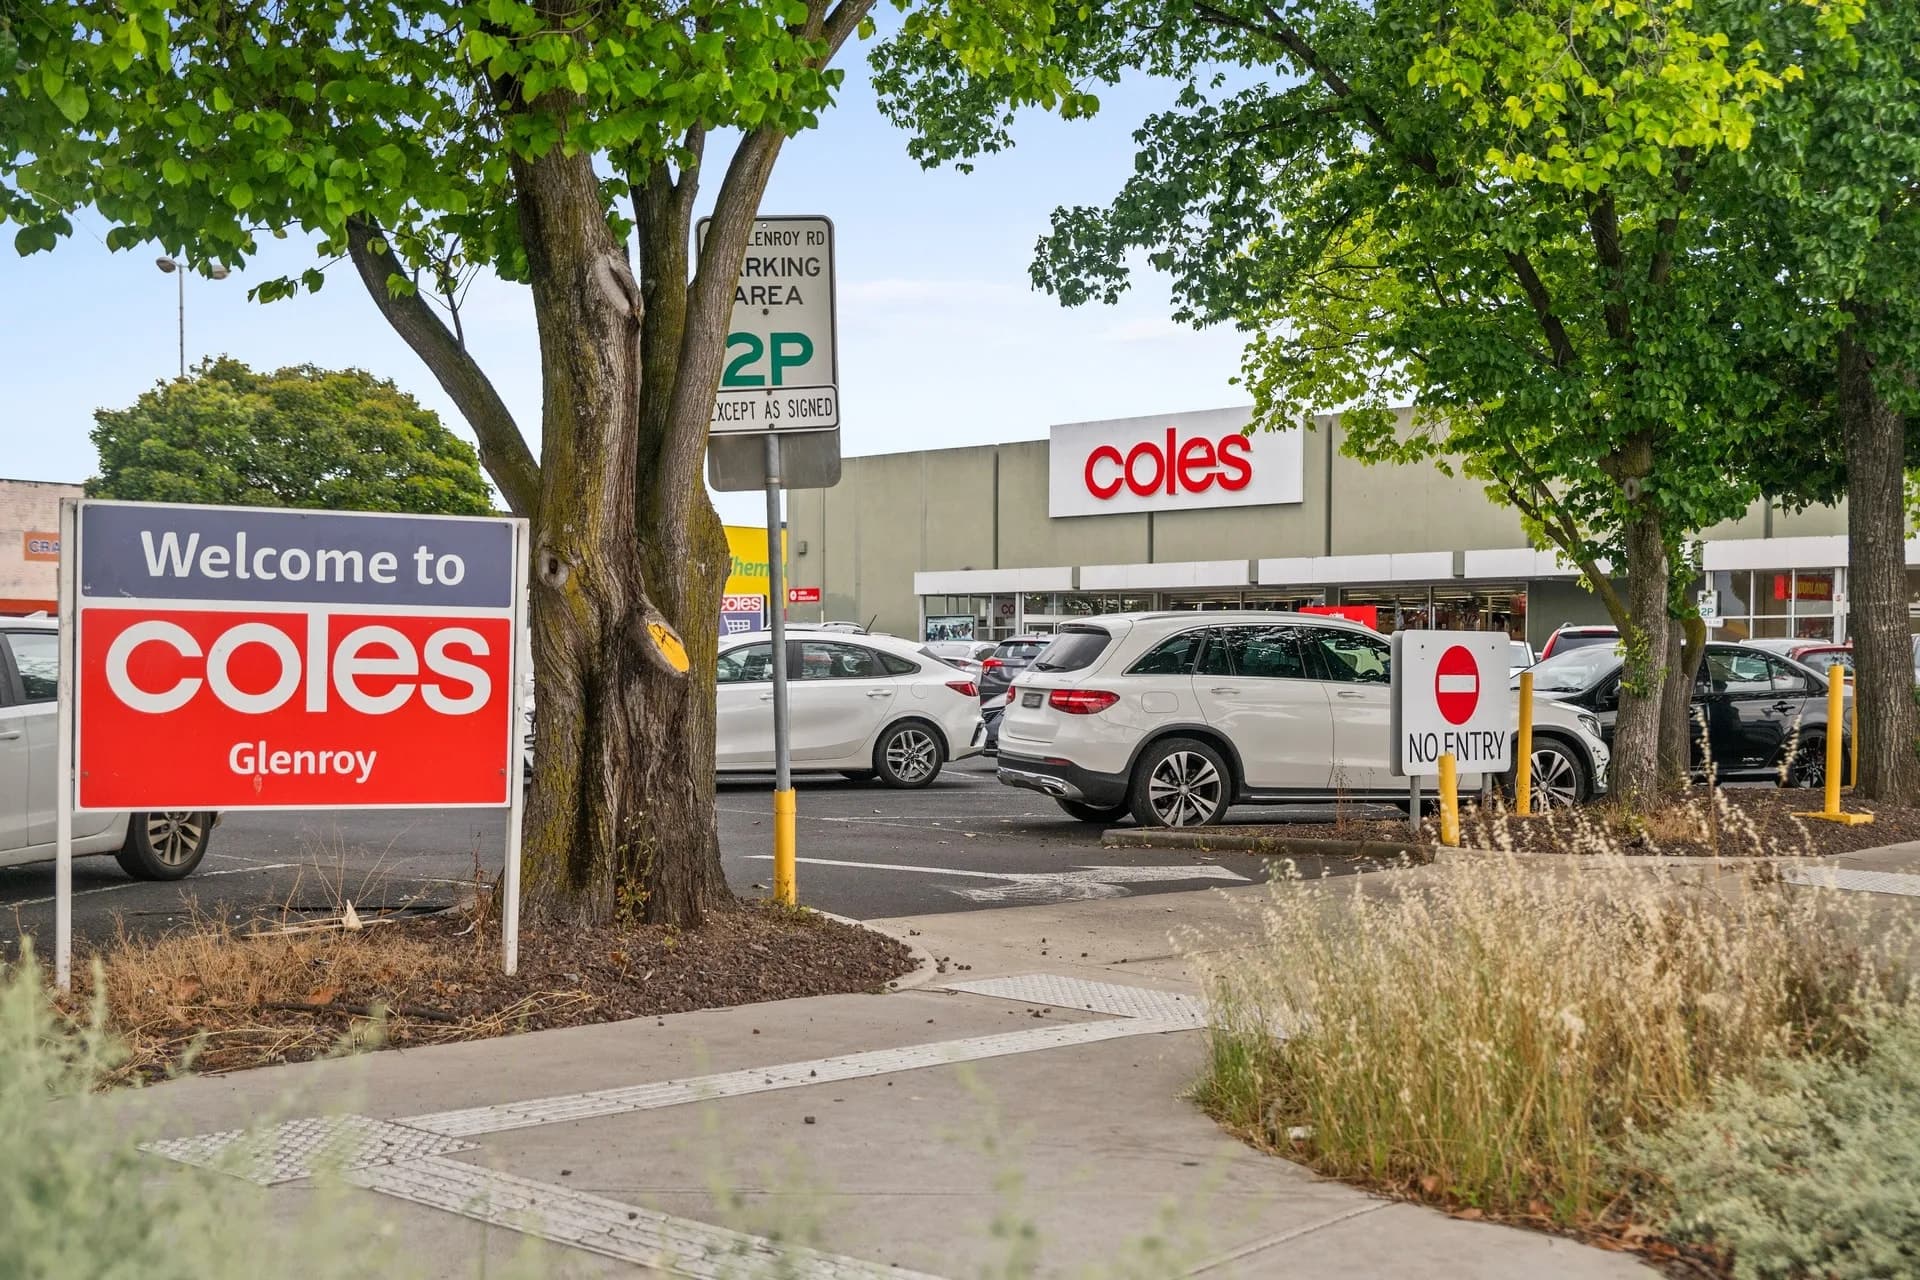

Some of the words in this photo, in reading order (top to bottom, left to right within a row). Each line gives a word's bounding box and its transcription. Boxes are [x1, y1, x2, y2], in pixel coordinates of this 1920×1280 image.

[747, 231, 800, 246] ENROY
[807, 231, 825, 246] RD
[740, 257, 821, 277] RKING
[735, 285, 803, 305] AREA
[721, 331, 814, 386] 2P
[711, 401, 756, 422] XCEPT
[764, 400, 781, 420] AS
[788, 397, 833, 418] SIGNED
[1084, 427, 1253, 500] coles
[140, 530, 398, 584] Welcome
[413, 545, 466, 586] to
[1701, 607, 1714, 616] 2P
[105, 612, 492, 715] coles
[228, 742, 377, 783] Glenroy
[1409, 732, 1438, 763] NO
[1444, 731, 1505, 761] ENTRY
